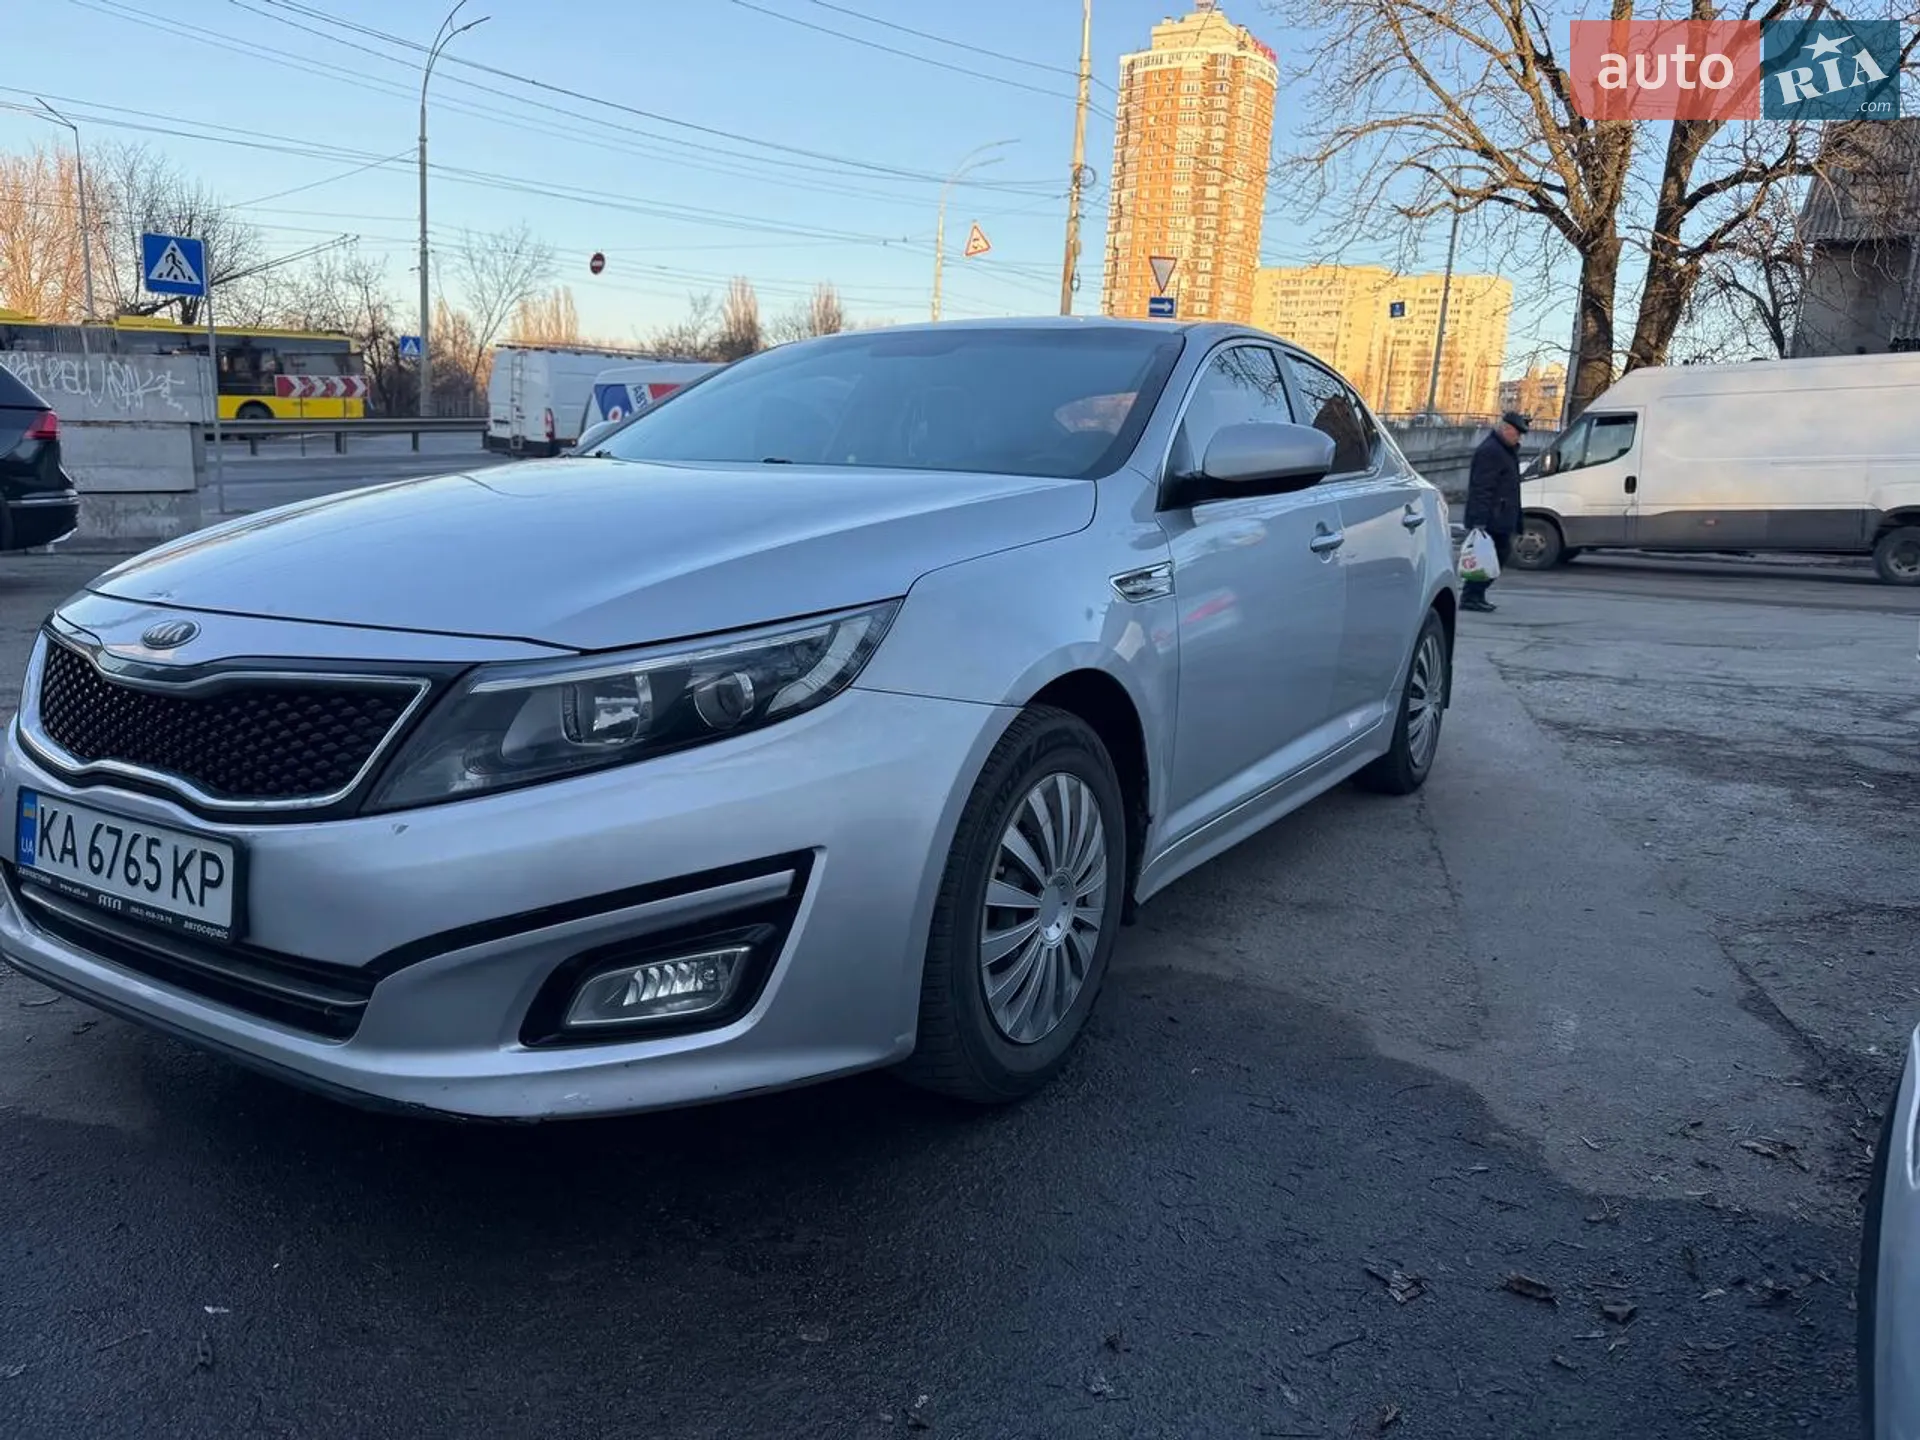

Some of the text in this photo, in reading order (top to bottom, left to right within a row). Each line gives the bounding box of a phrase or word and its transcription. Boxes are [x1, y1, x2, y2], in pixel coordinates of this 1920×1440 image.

[21, 837, 34, 853] UA
[38, 803, 225, 908] KA 6765 KP
